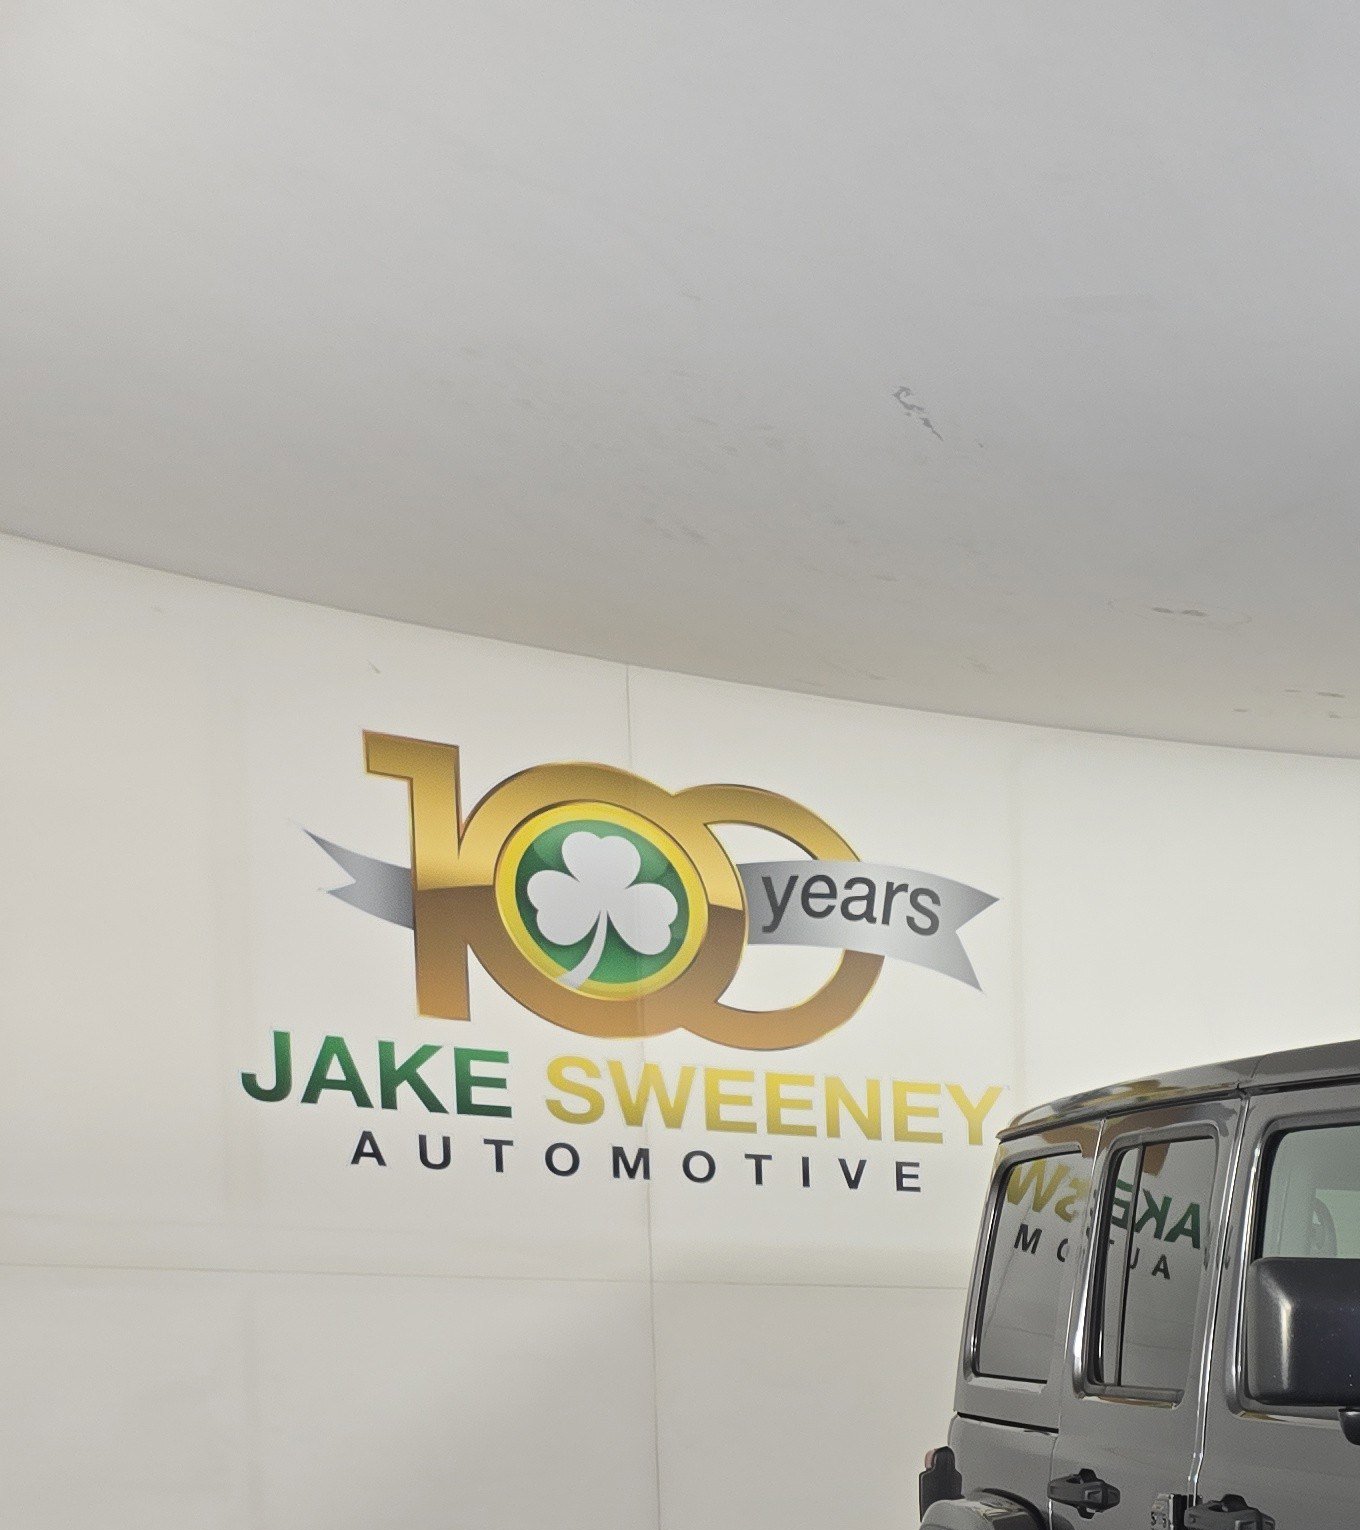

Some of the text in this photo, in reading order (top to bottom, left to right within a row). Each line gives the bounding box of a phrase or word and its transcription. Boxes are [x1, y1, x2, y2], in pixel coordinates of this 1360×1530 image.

[760, 872, 944, 937] years
[240, 1029, 1004, 1147] JAKE SWEENEY
[350, 1129, 923, 1193] AUTOMOTIVE
